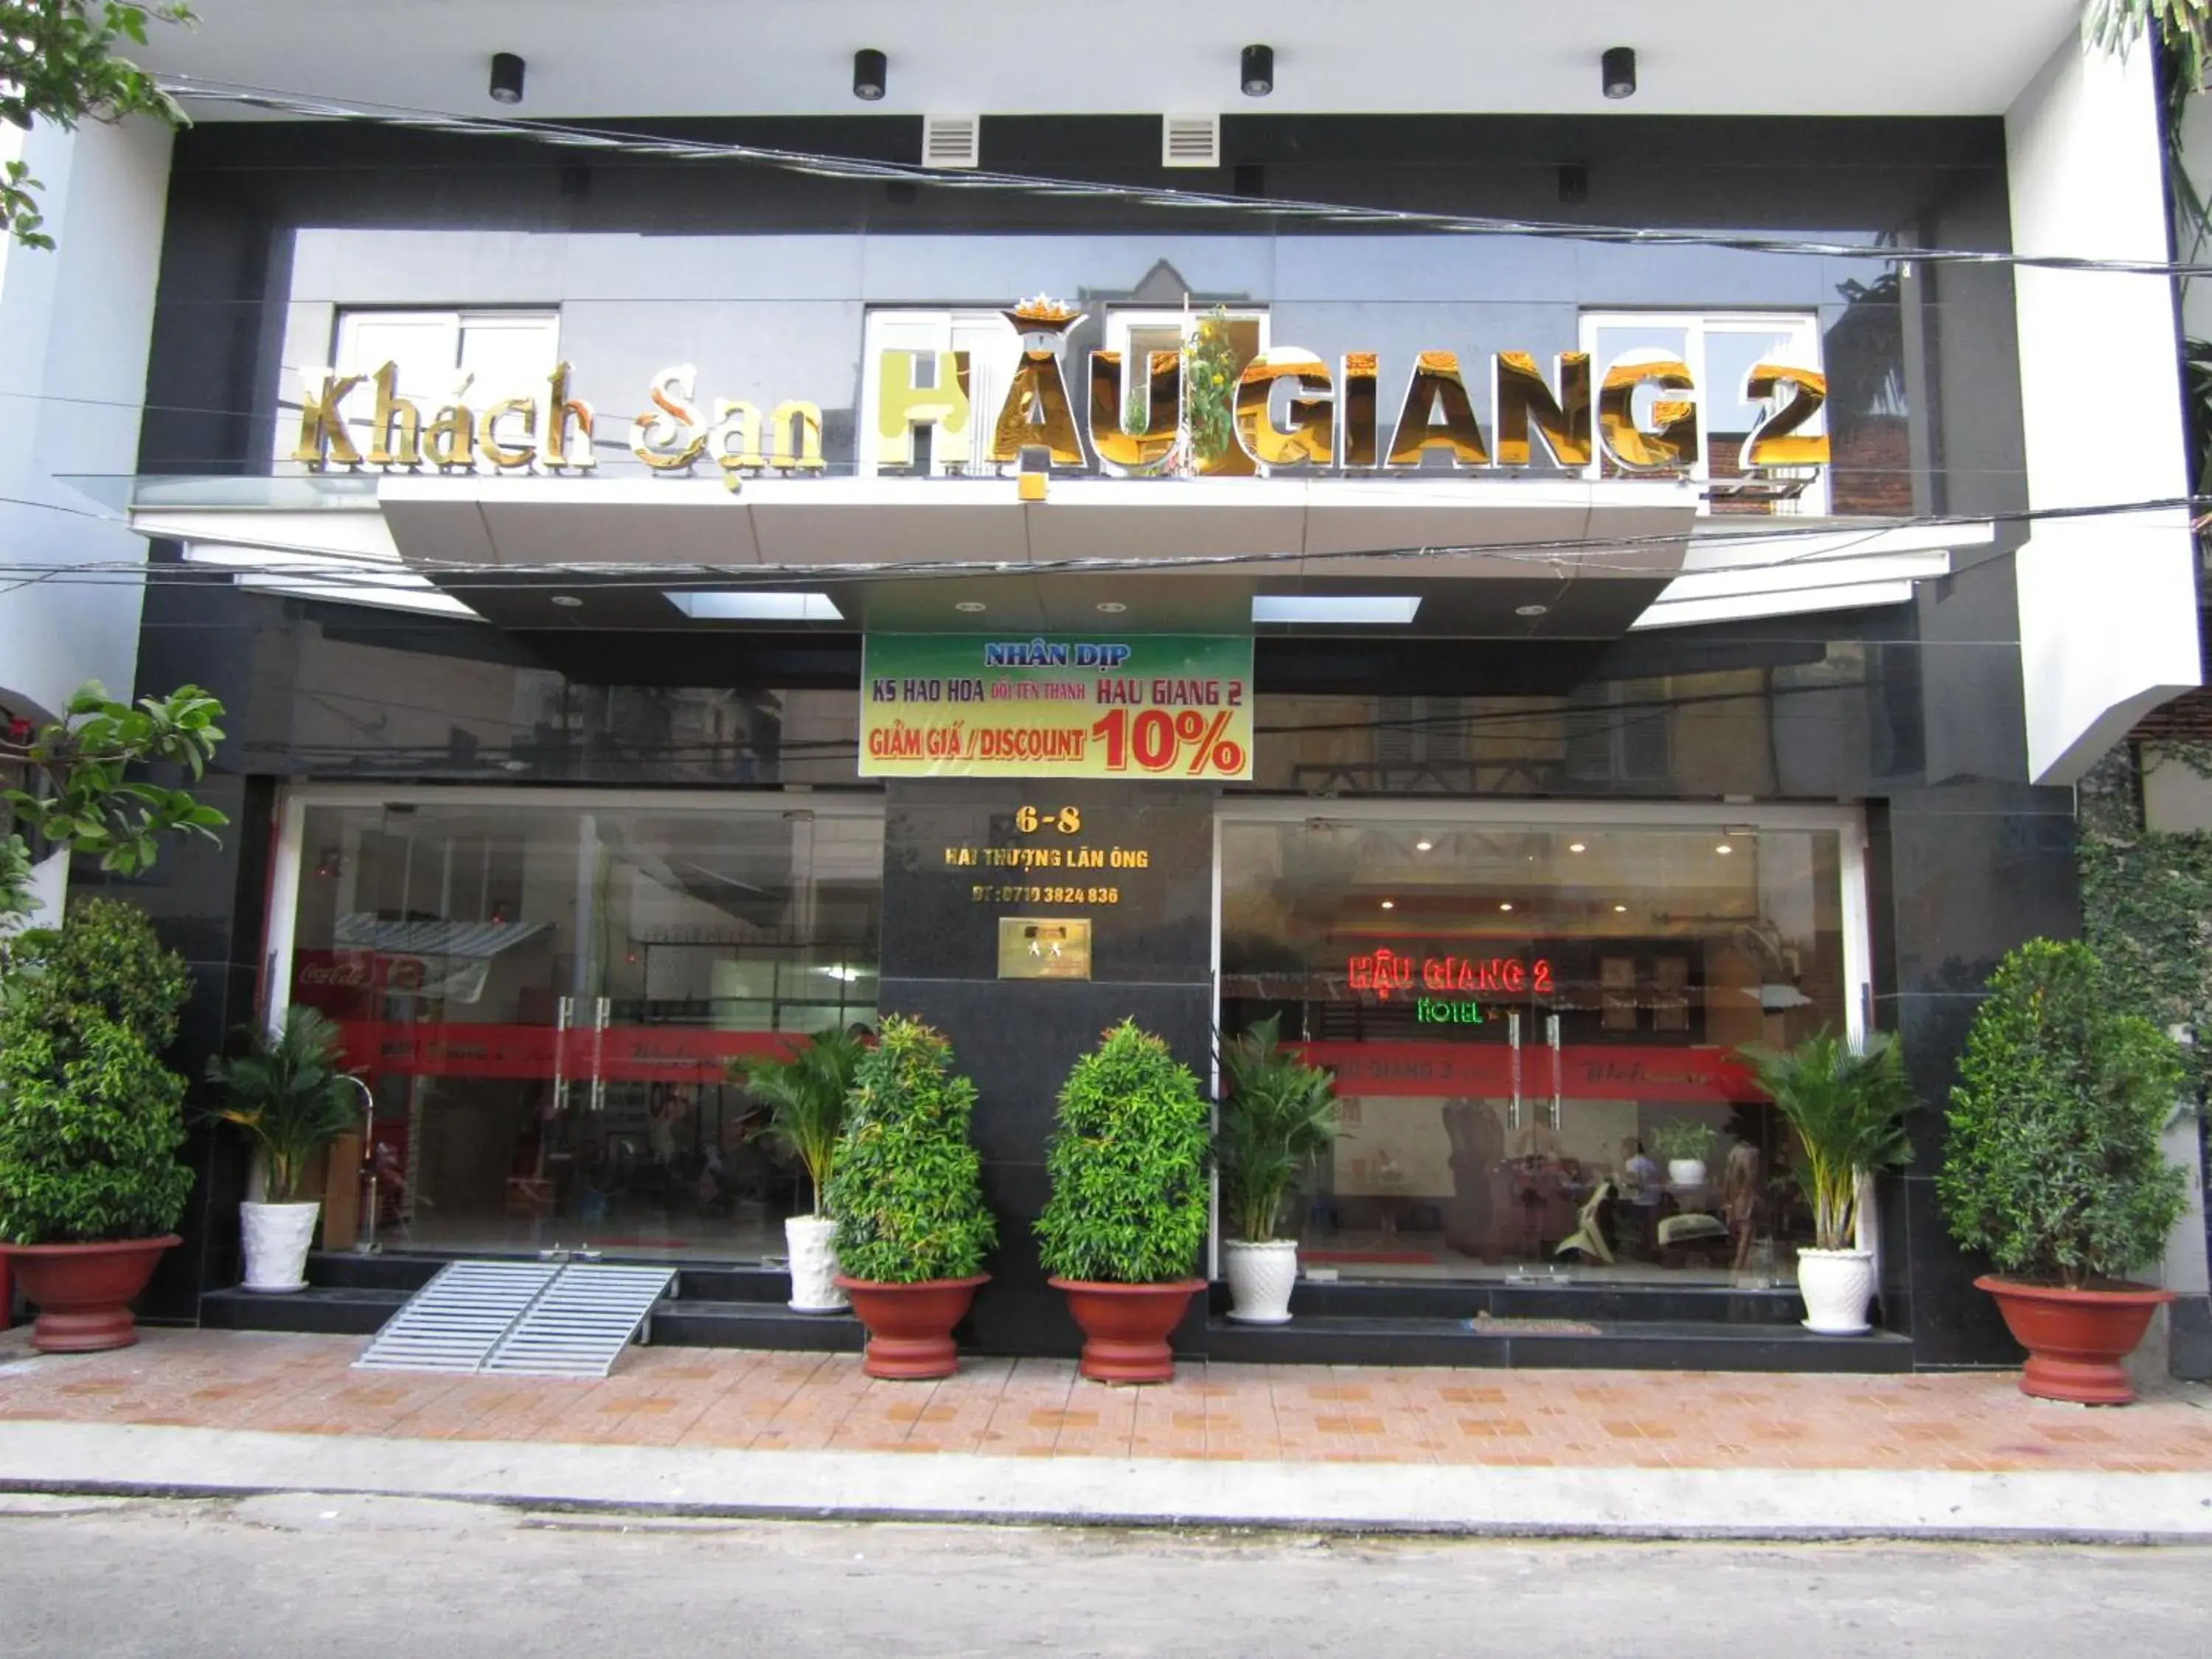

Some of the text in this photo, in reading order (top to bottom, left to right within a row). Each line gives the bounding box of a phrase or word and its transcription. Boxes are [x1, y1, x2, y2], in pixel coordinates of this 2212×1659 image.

[291, 360, 599, 472] Khách
[1232, 345, 1698, 470] GIANG
[1738, 361, 1831, 470] 2
[984, 637, 1131, 672] NHÂN DỊP
[872, 678, 897, 702] KS
[1151, 679, 1220, 706] GIANG
[1227, 680, 1242, 707] 2
[869, 718, 923, 759] GIẢM
[1091, 708, 1246, 775] 10%
[1015, 805, 1082, 835] 6-8
[1110, 845, 1150, 869] ÔNG
[1043, 886, 1085, 904] 3824
[1087, 887, 1119, 905] 836
[1422, 956, 1526, 992] GIANG
[1533, 959, 1554, 992] 2
[1416, 995, 1484, 1025] HOTEL
